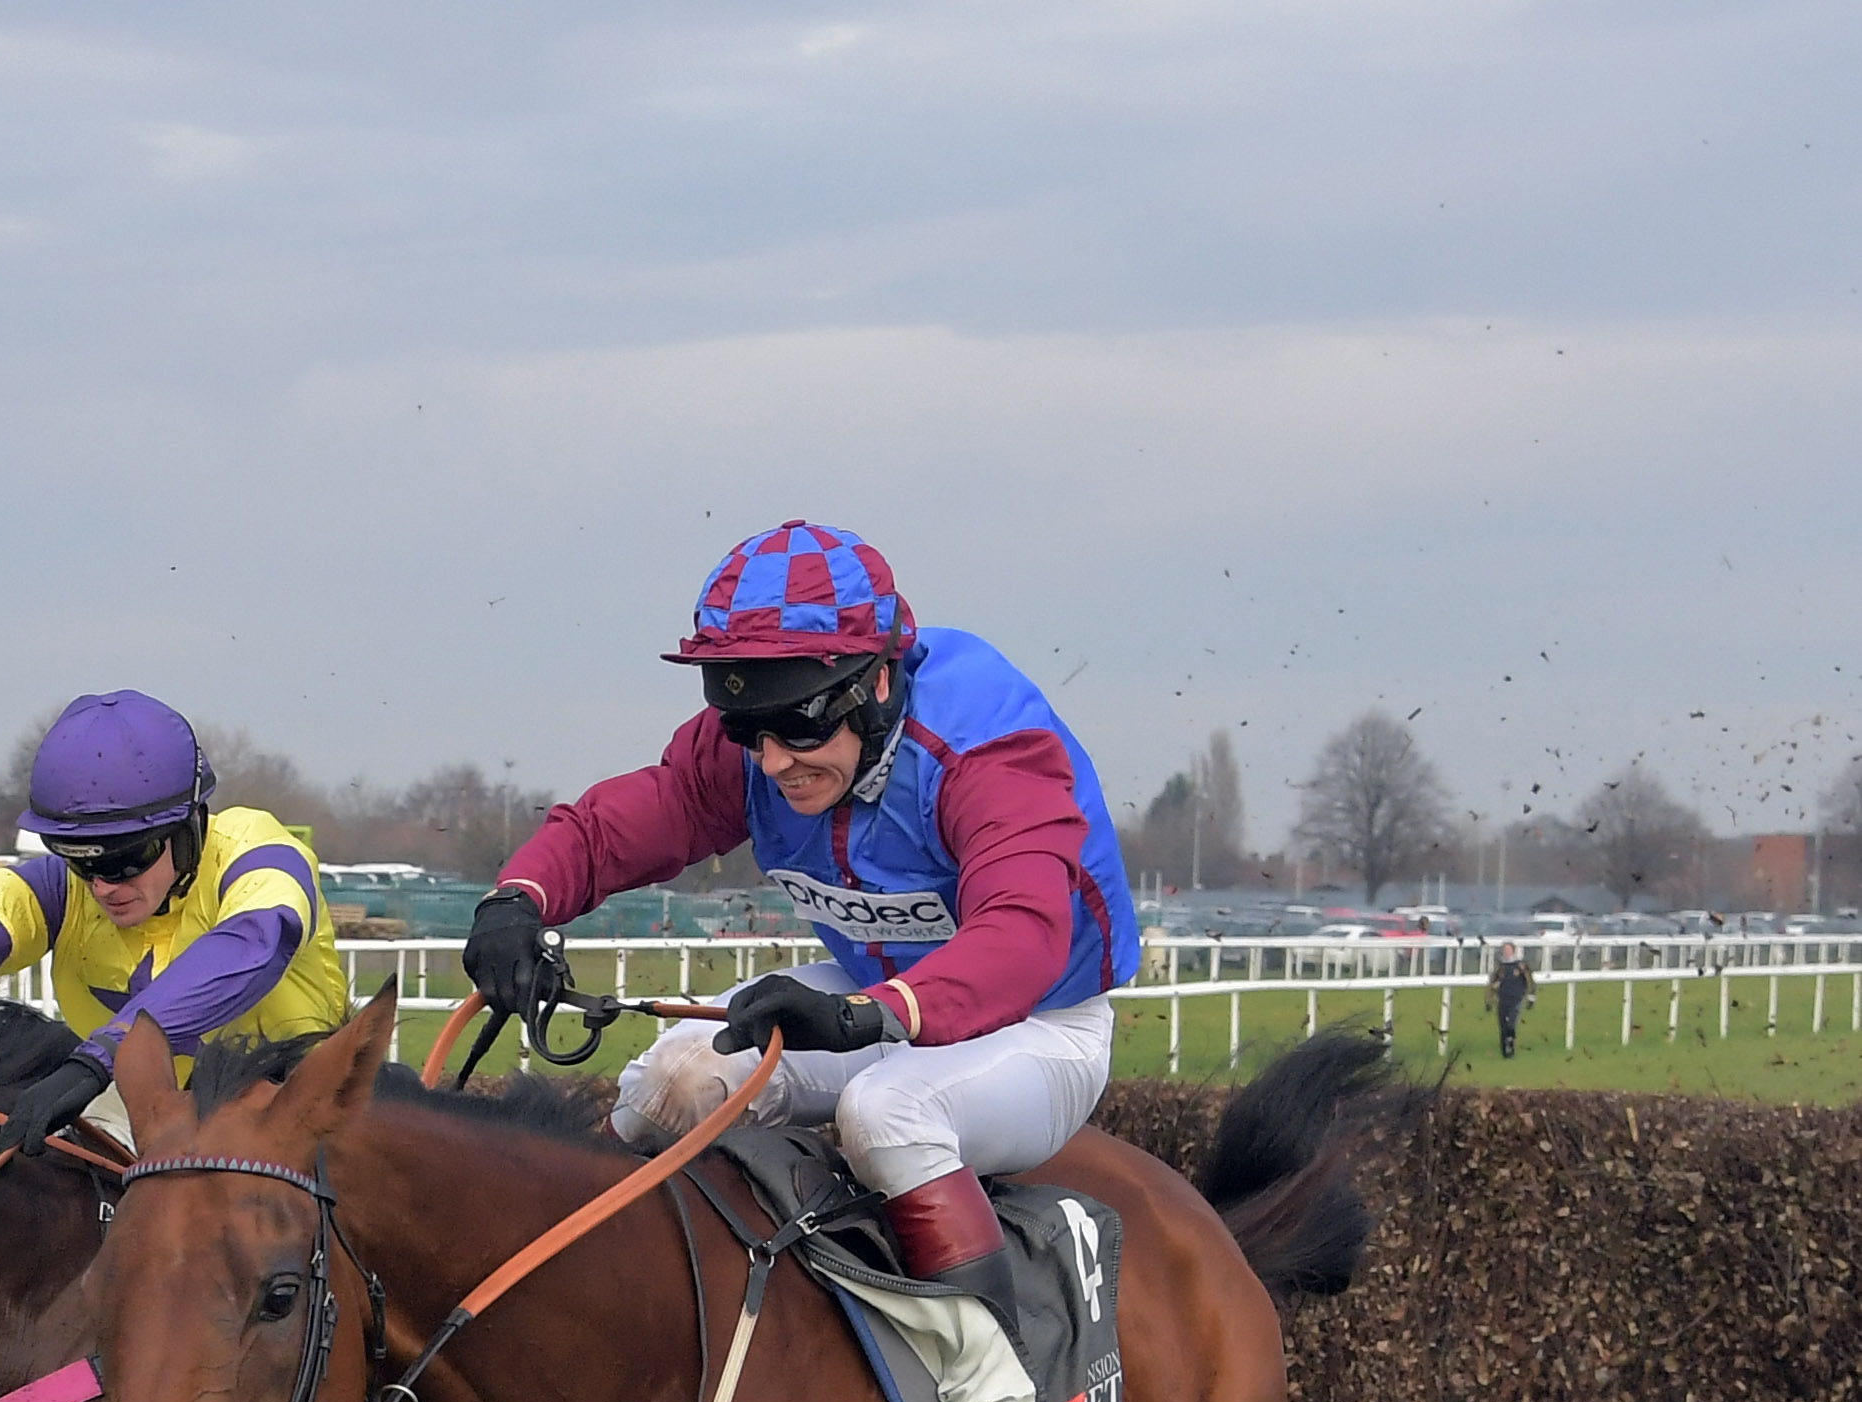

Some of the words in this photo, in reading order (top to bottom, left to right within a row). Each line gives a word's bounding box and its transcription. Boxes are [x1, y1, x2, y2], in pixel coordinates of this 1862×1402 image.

[780, 879, 945, 925] prodec
[849, 923, 953, 937] ETWORKS
[1057, 1198, 1103, 1323] 4
